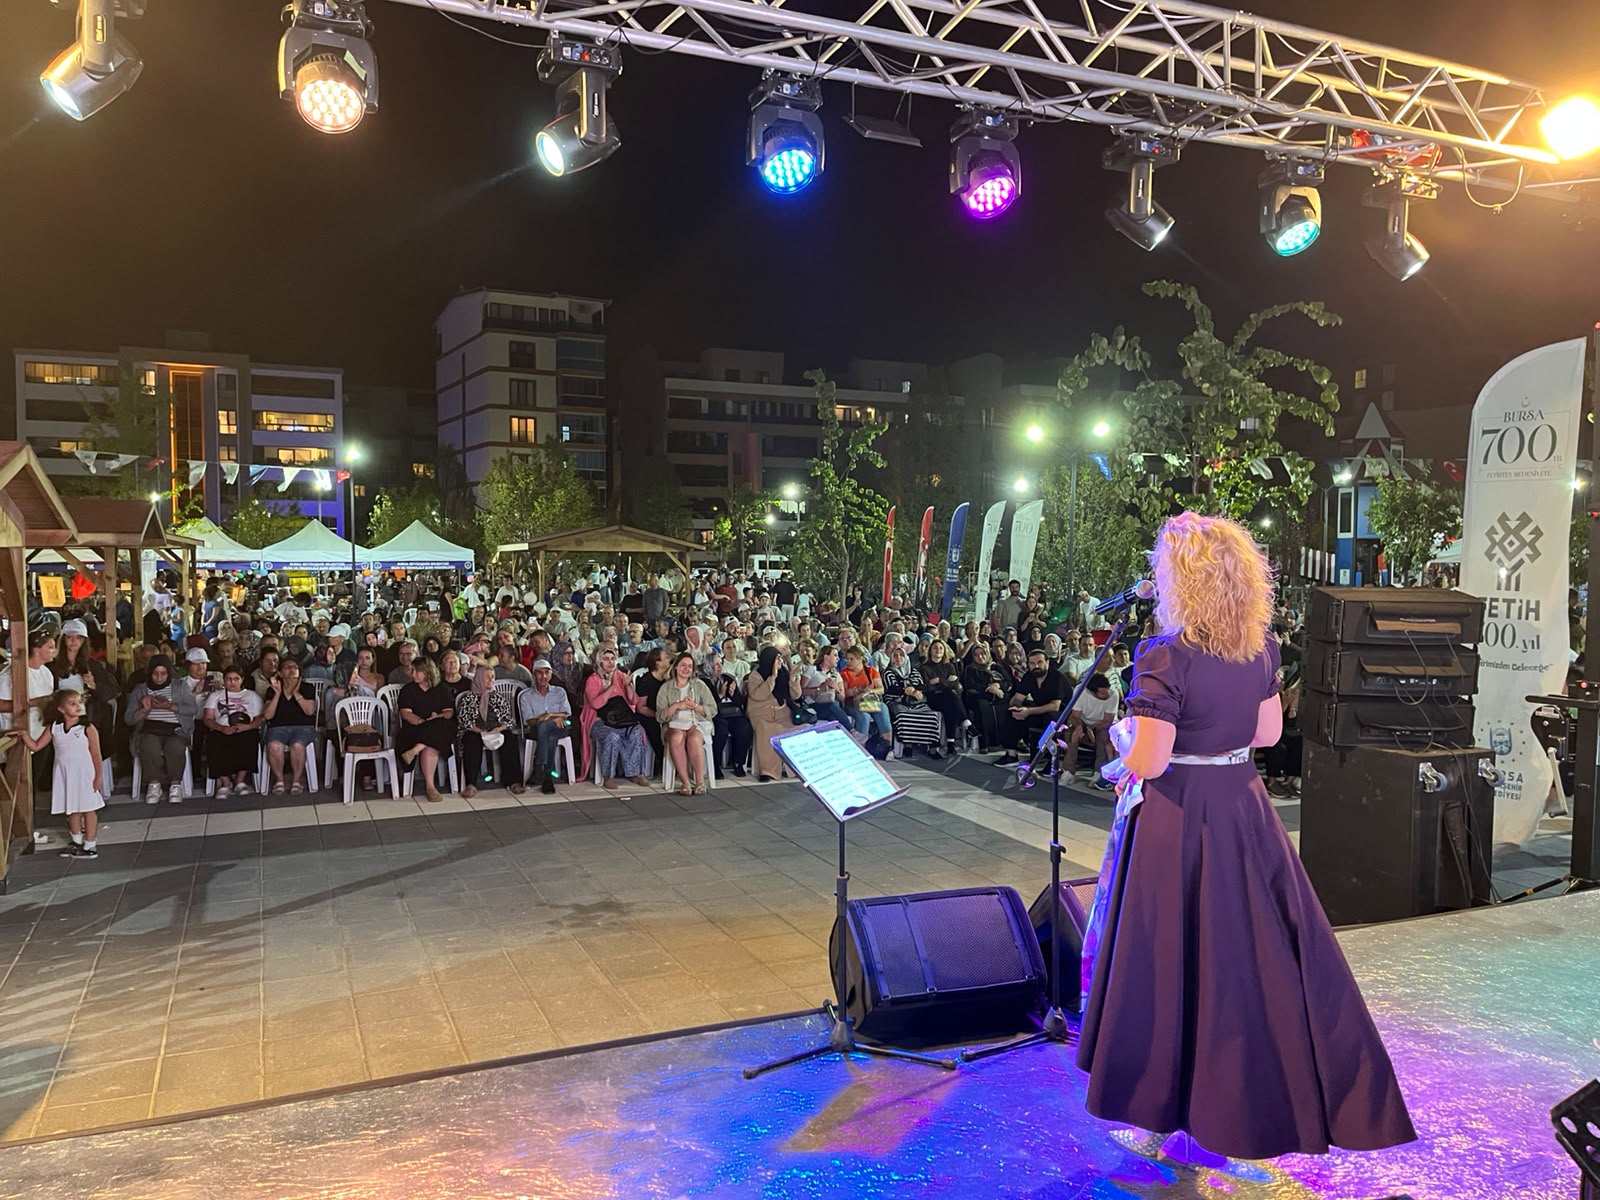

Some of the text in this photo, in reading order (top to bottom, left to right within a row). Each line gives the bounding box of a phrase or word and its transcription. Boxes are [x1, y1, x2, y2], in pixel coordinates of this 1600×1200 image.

[1503, 409, 1545, 424] BURSA
[1480, 424, 1558, 465] 700
[1484, 621, 1540, 653] 00. yıl
